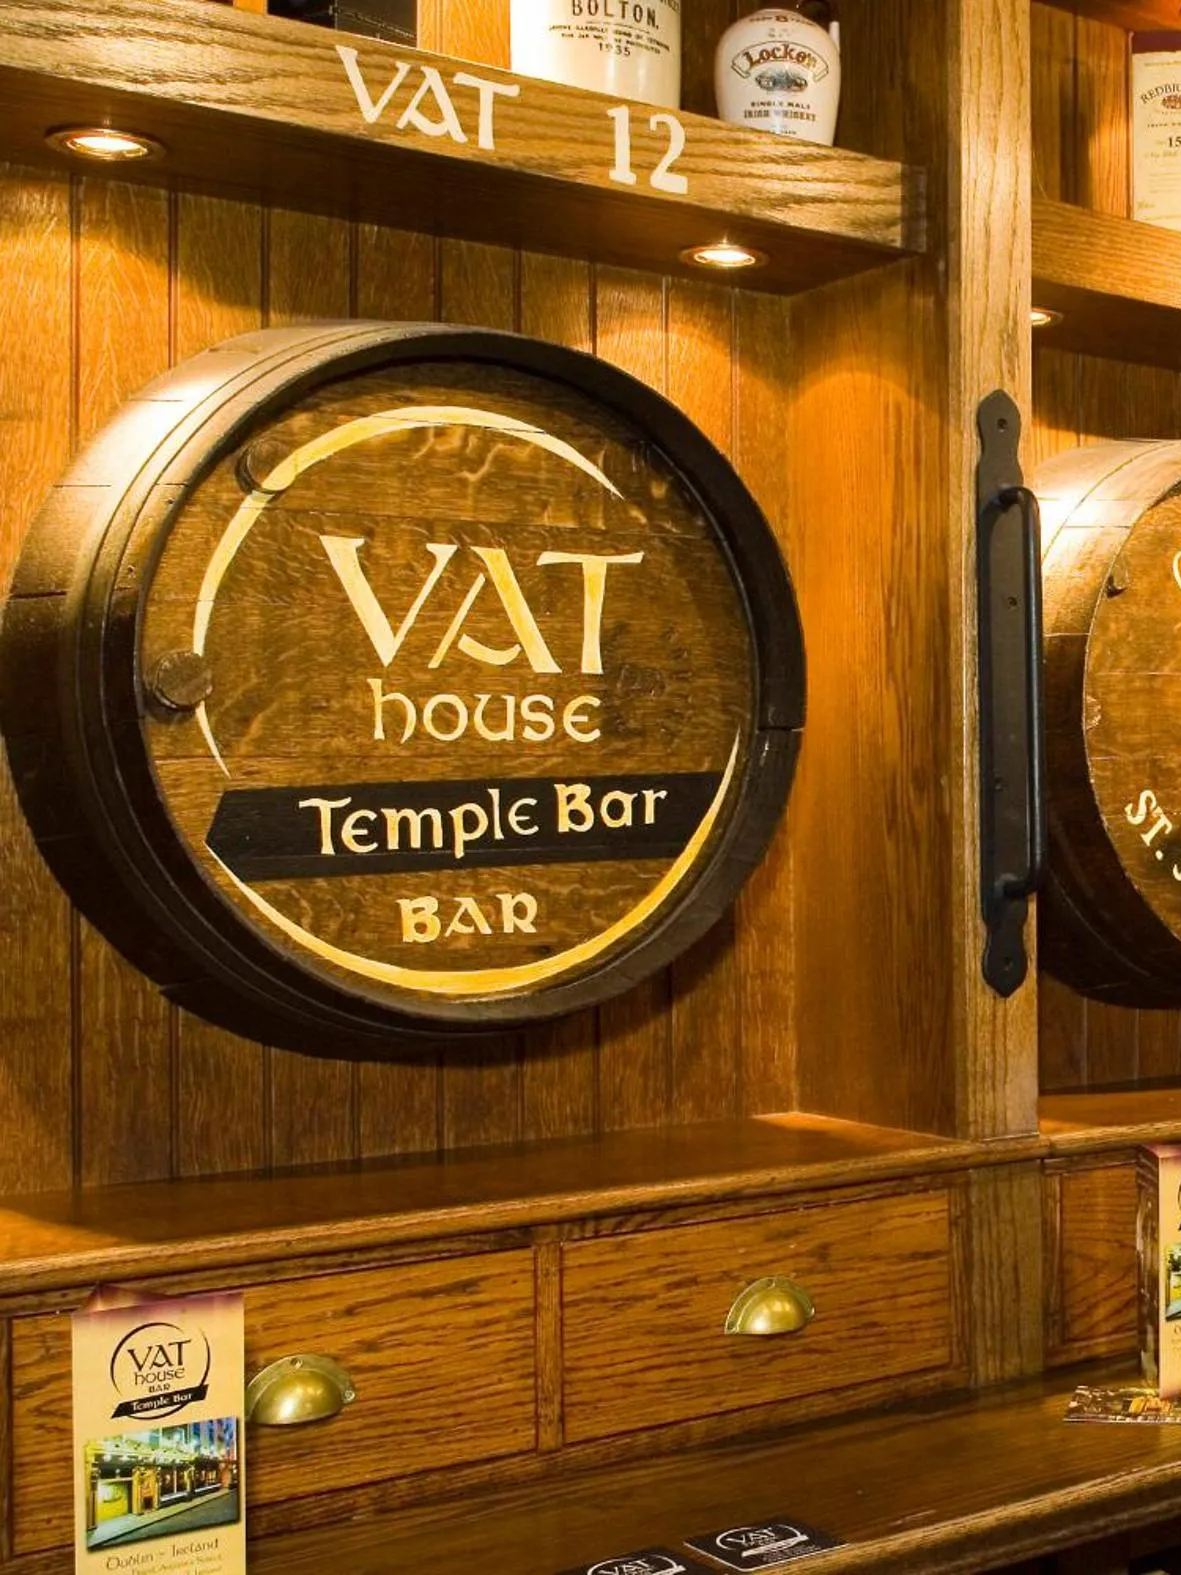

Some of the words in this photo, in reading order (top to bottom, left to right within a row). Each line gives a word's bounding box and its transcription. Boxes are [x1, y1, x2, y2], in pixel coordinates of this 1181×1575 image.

[599, 42, 631, 57] 1935
[335, 44, 520, 150] VAT
[607, 104, 689, 195] 12
[319, 535, 645, 676] VAT
[367, 678, 601, 744] house
[299, 788, 539, 859] Temple
[555, 782, 668, 834] Bar
[1125, 789, 1173, 861] ST.
[396, 892, 538, 944] BAR
[127, 1338, 192, 1373] VAT
[135, 1365, 186, 1387] house
[130, 1394, 171, 1414] Temple
[173, 1390, 193, 1404] Bar
[148, 1383, 171, 1394] BAR
[105, 1551, 154, 1572] Dublin
[171, 1537, 220, 1558] Ireland
